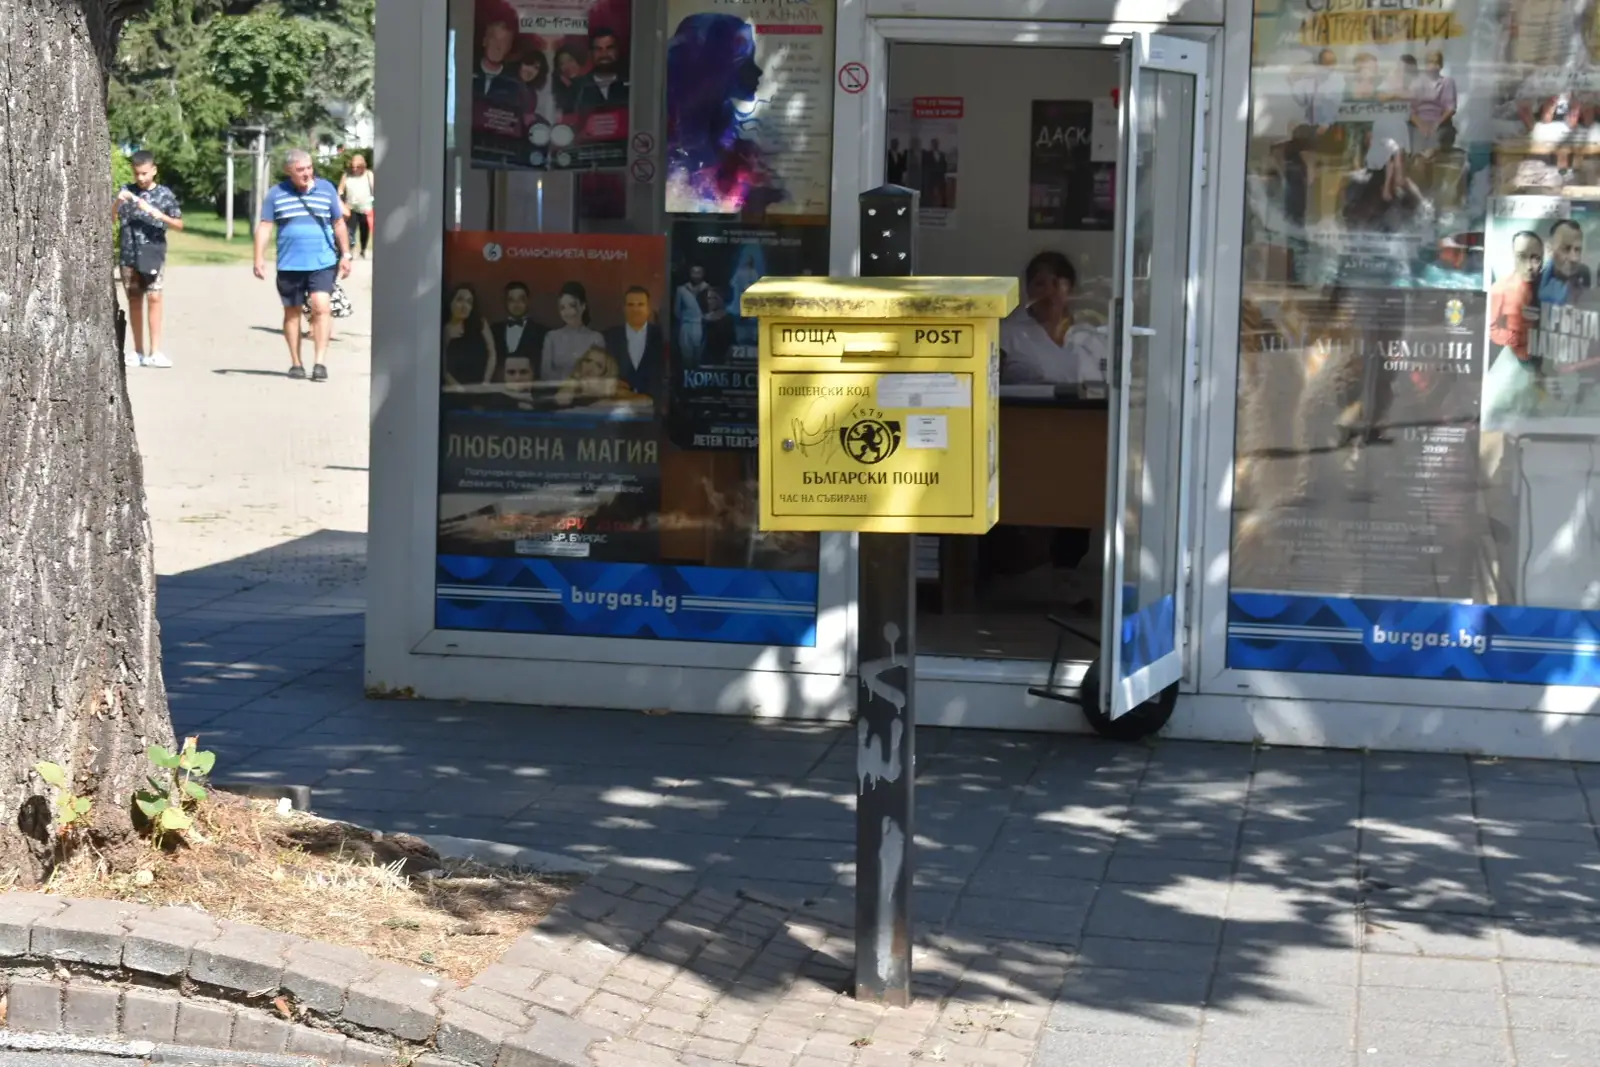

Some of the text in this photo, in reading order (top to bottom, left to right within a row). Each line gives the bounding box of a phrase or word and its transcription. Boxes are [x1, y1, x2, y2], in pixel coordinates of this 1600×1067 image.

[506, 246, 628, 261] СИМФОНИЕТА ВИДИН
[782, 328, 837, 345] ПОЩА
[915, 329, 962, 344] POST
[683, 369, 729, 388] КОРАБ
[732, 373, 741, 387] В
[778, 386, 843, 397] ПОЩЕНСКИ
[847, 386, 870, 397] КОД
[852, 408, 883, 419] 1879
[446, 434, 658, 464] ЛЮБОВНА МАГИЯ
[803, 471, 940, 486] БЪЛГАРСКИ ПОЩИ
[779, 493, 798, 502] ЧАС
[801, 494, 815, 502] НА
[571, 586, 678, 613] burgas.bg
[1373, 625, 1487, 655] burgas.bg
